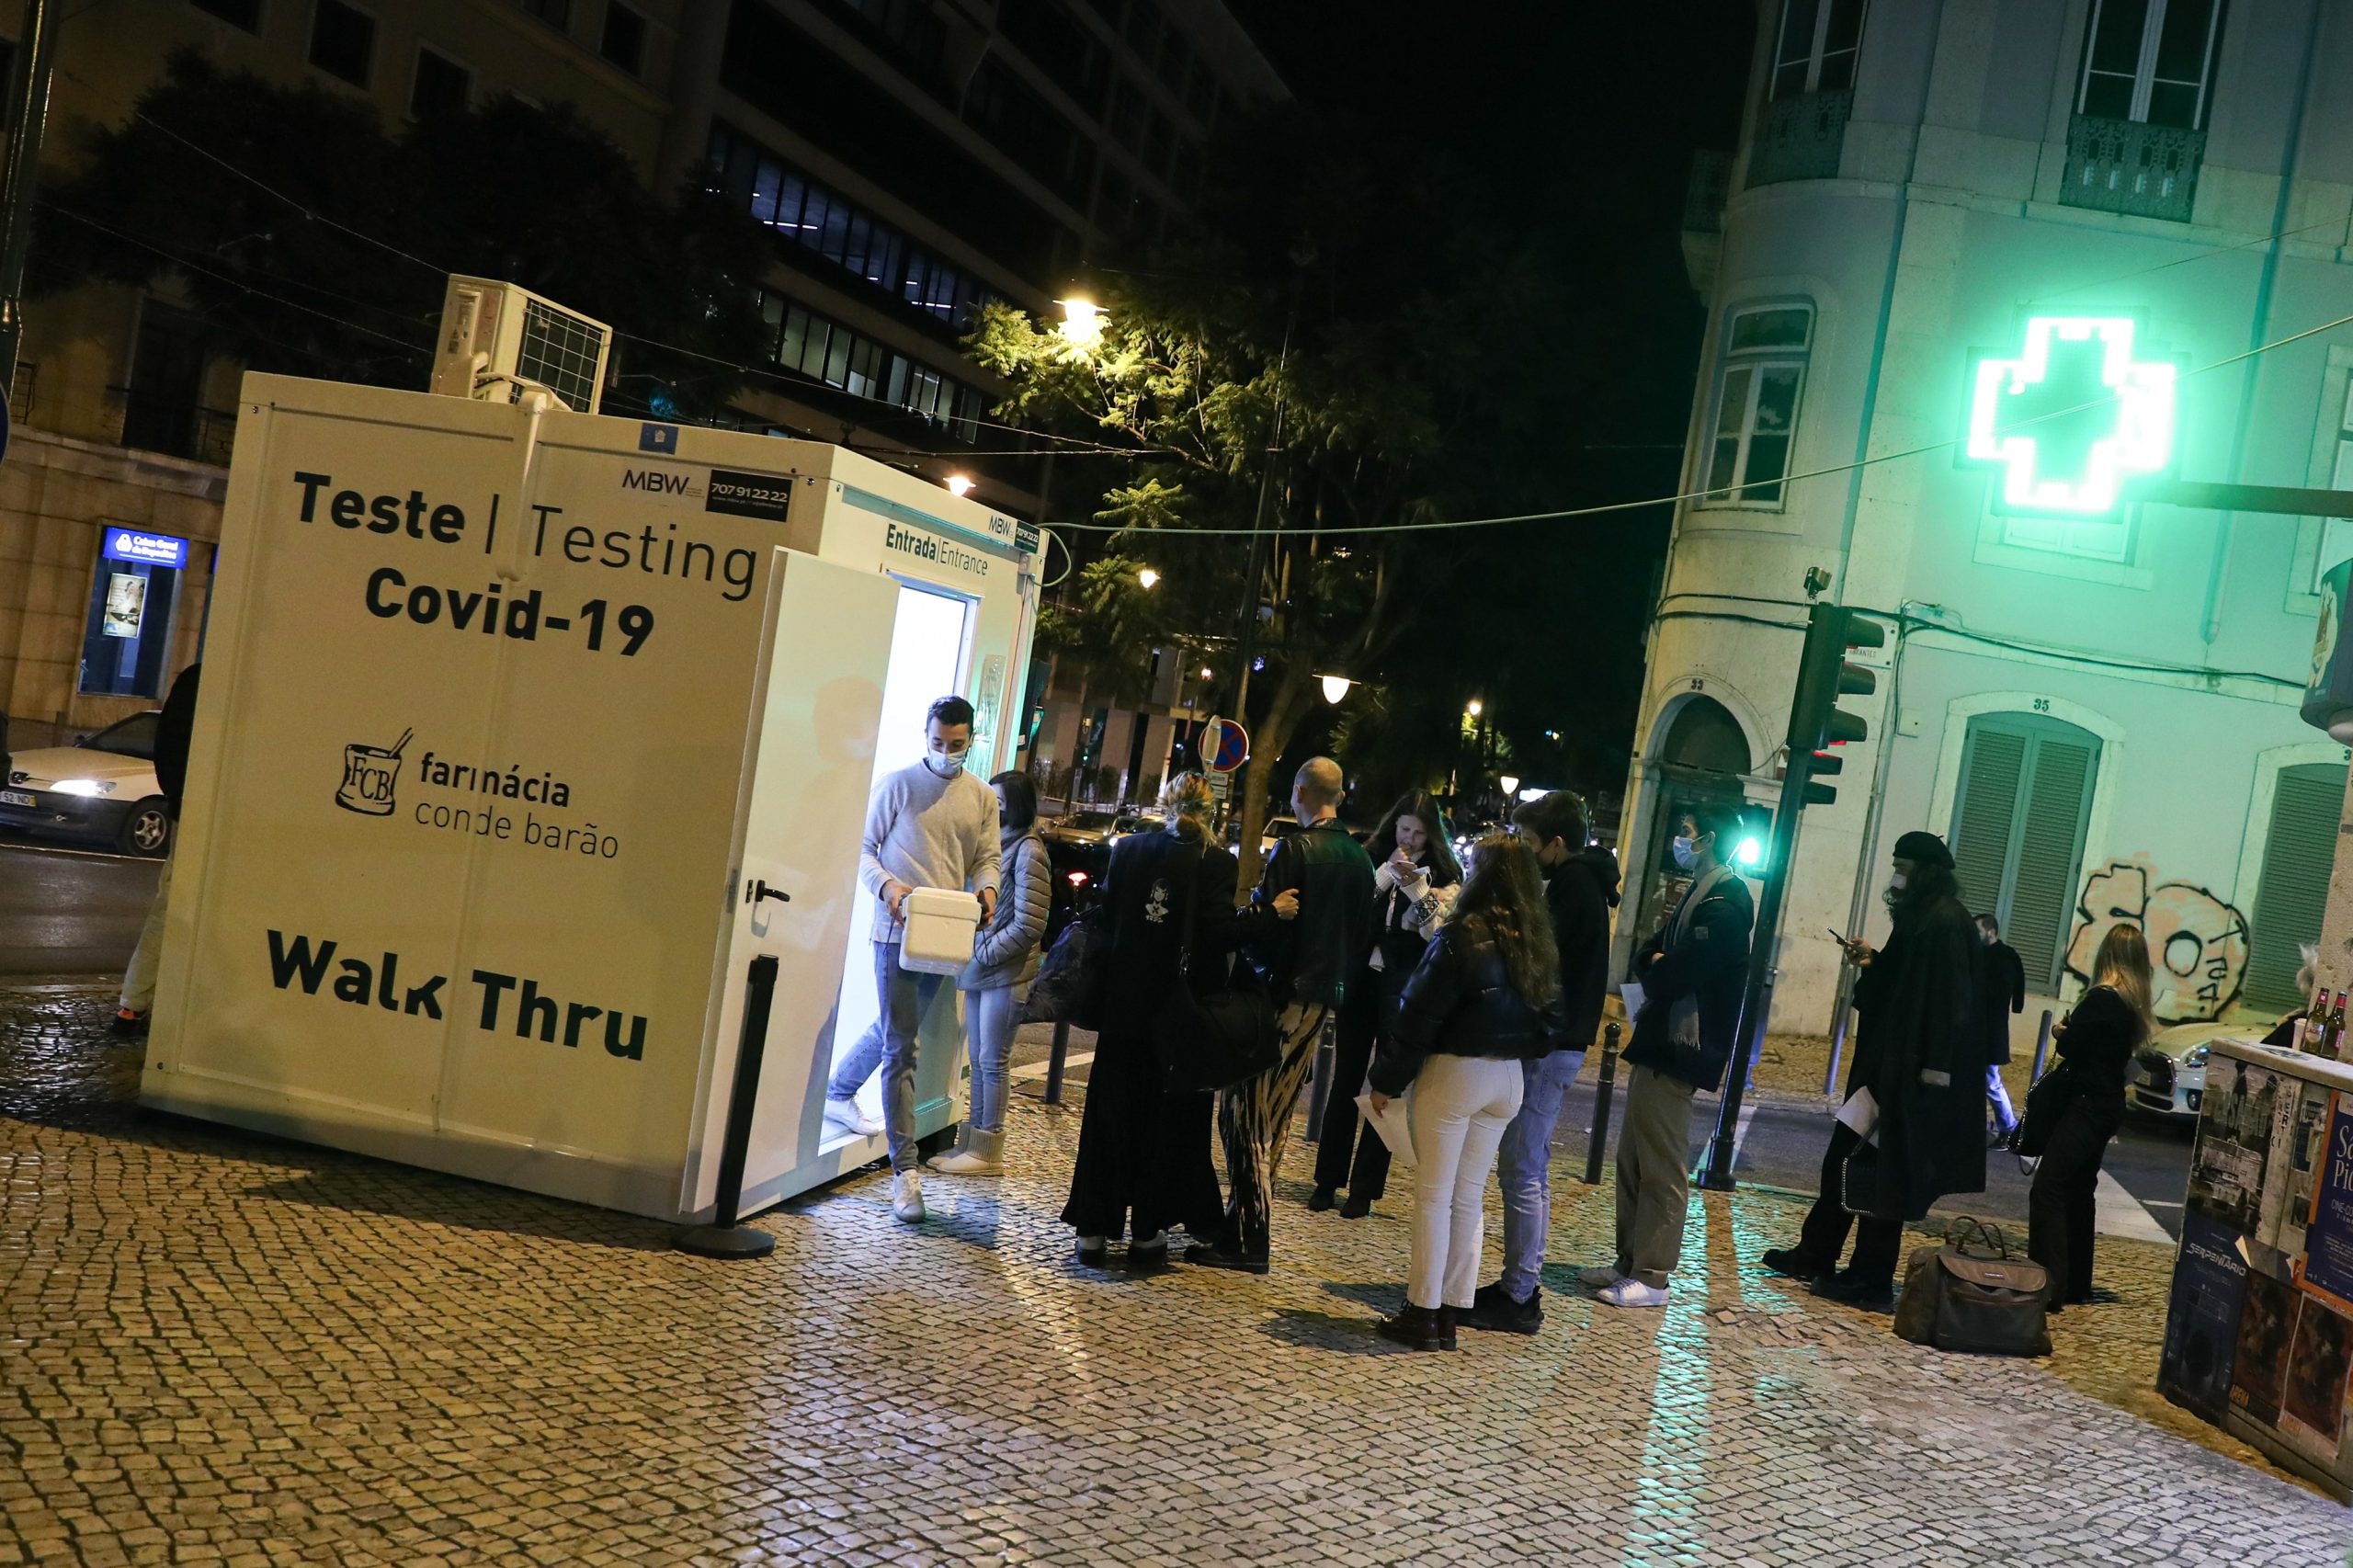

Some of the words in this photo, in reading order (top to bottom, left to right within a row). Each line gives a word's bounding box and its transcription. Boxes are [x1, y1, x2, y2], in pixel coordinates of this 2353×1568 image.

[621, 469, 689, 494] MBW
[711, 483, 736, 494] 707
[736, 486, 751, 497] 91
[751, 488, 769, 500] 22
[770, 491, 788, 503] 22
[294, 471, 465, 544] Teste
[530, 504, 757, 602] Testing
[988, 515, 1012, 537] MBW
[885, 523, 937, 561] Entrada
[939, 540, 988, 575] Entrance
[365, 567, 654, 656] Covid-19
[1690, 678, 1704, 691] 33
[2033, 698, 2050, 712] 35
[2343, 749, 2352, 761] 3
[349, 756, 392, 801] FCB
[420, 752, 571, 808] farmácia
[415, 802, 512, 839] conde
[524, 812, 619, 858] barão
[267, 928, 448, 1020] Walk
[472, 969, 648, 1062] Thru
